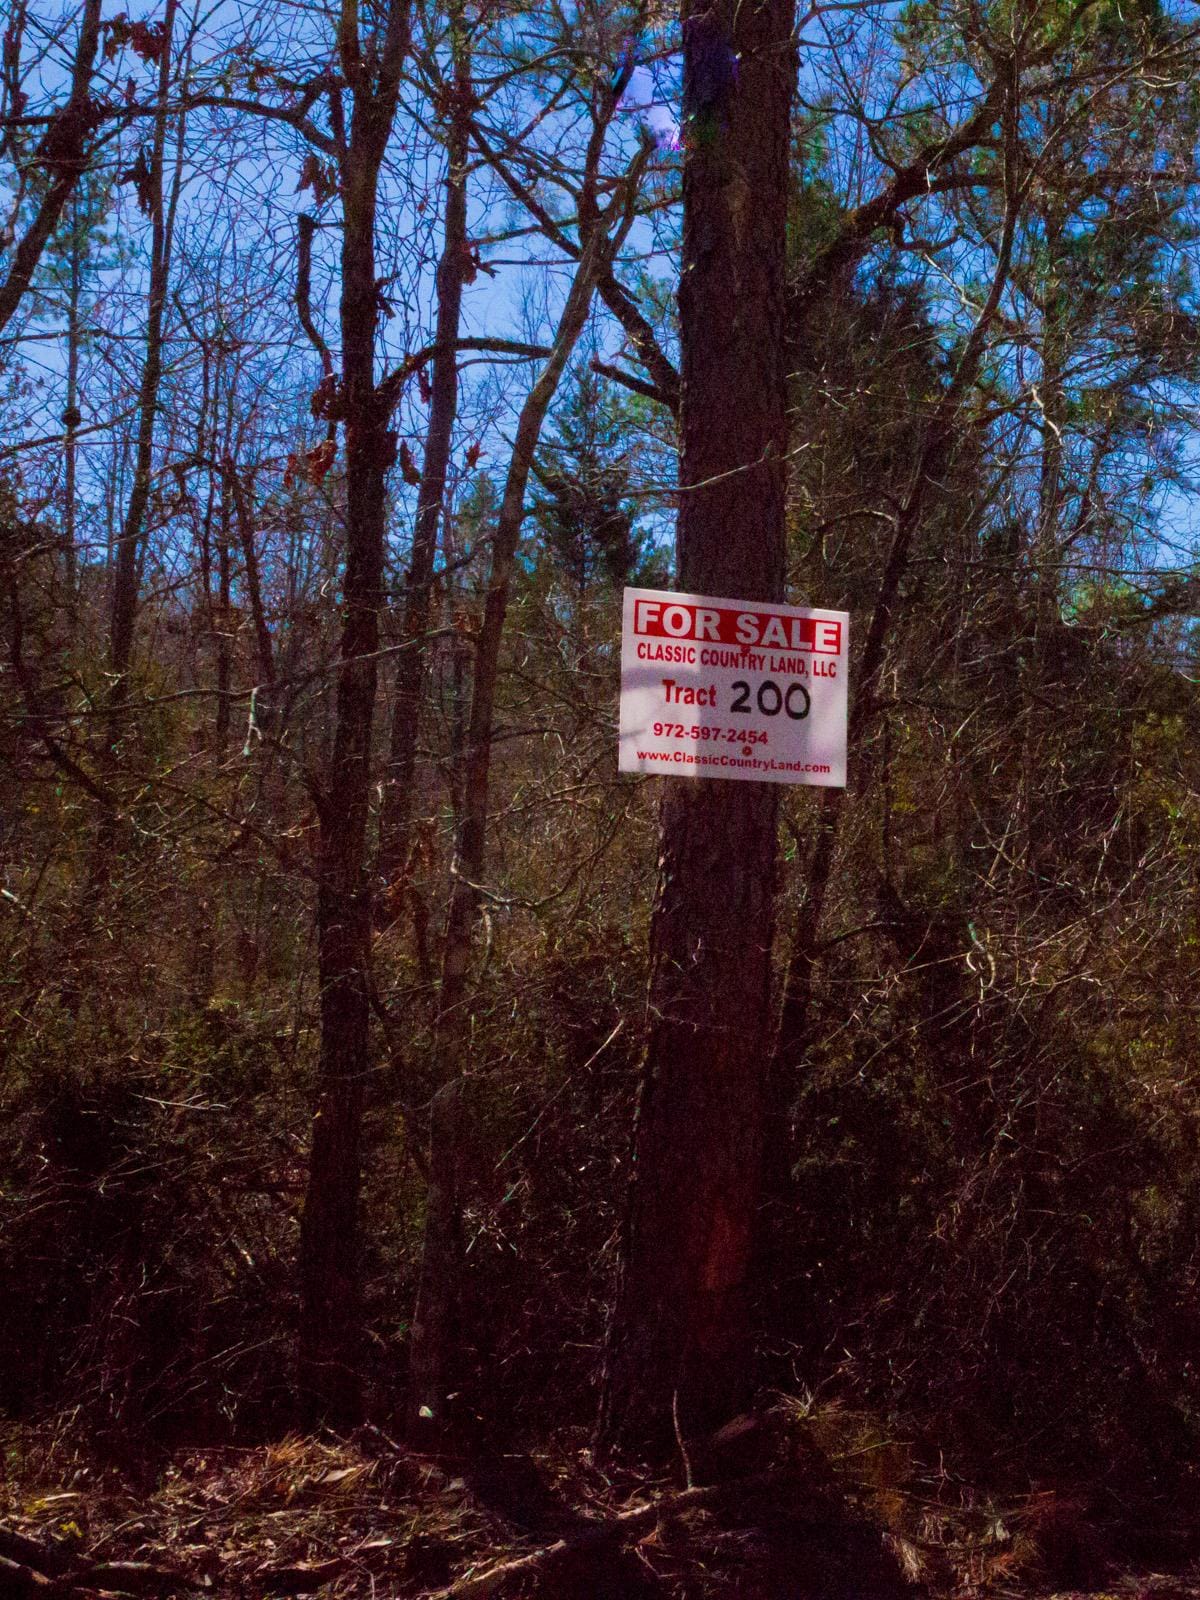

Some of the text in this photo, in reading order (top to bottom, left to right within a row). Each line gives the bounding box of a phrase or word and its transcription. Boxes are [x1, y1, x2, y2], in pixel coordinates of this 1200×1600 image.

[637, 602, 838, 653] FOR SALE
[637, 642, 837, 678] CLASSIC COUNTRY LAND, LLC
[662, 679, 811, 720] Tract 200
[653, 722, 768, 744] 972-597-2454
[637, 751, 831, 773] www.ClassicCountryLand.com
